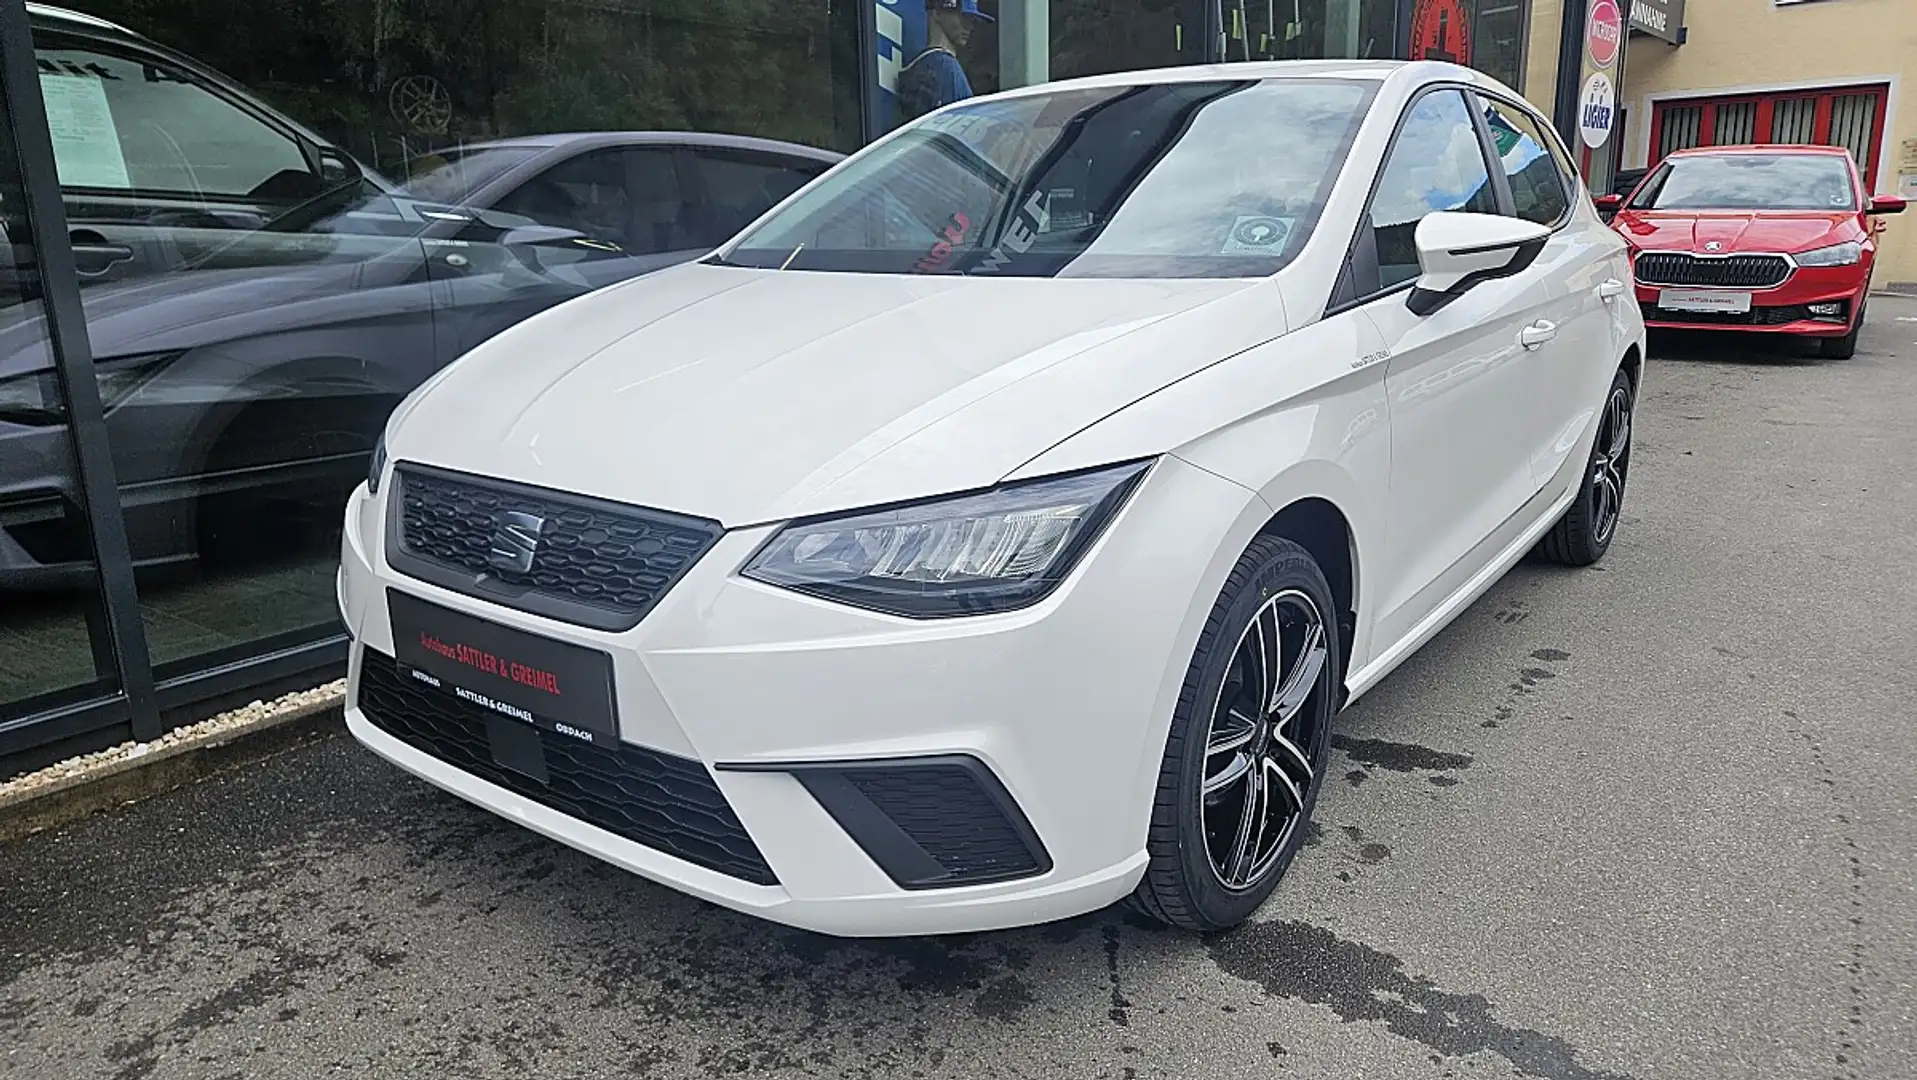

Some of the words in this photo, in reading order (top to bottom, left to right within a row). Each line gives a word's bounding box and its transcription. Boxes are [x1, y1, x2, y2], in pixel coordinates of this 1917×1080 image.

[1583, 104, 1611, 130] LIGIER
[456, 643, 498, 674] SATTLER
[499, 658, 509, 678] &
[511, 663, 561, 695] GREIMEL
[455, 686, 488, 708] SATTLER
[496, 701, 534, 723] GREIMEL
[556, 723, 593, 742] OBDACH
